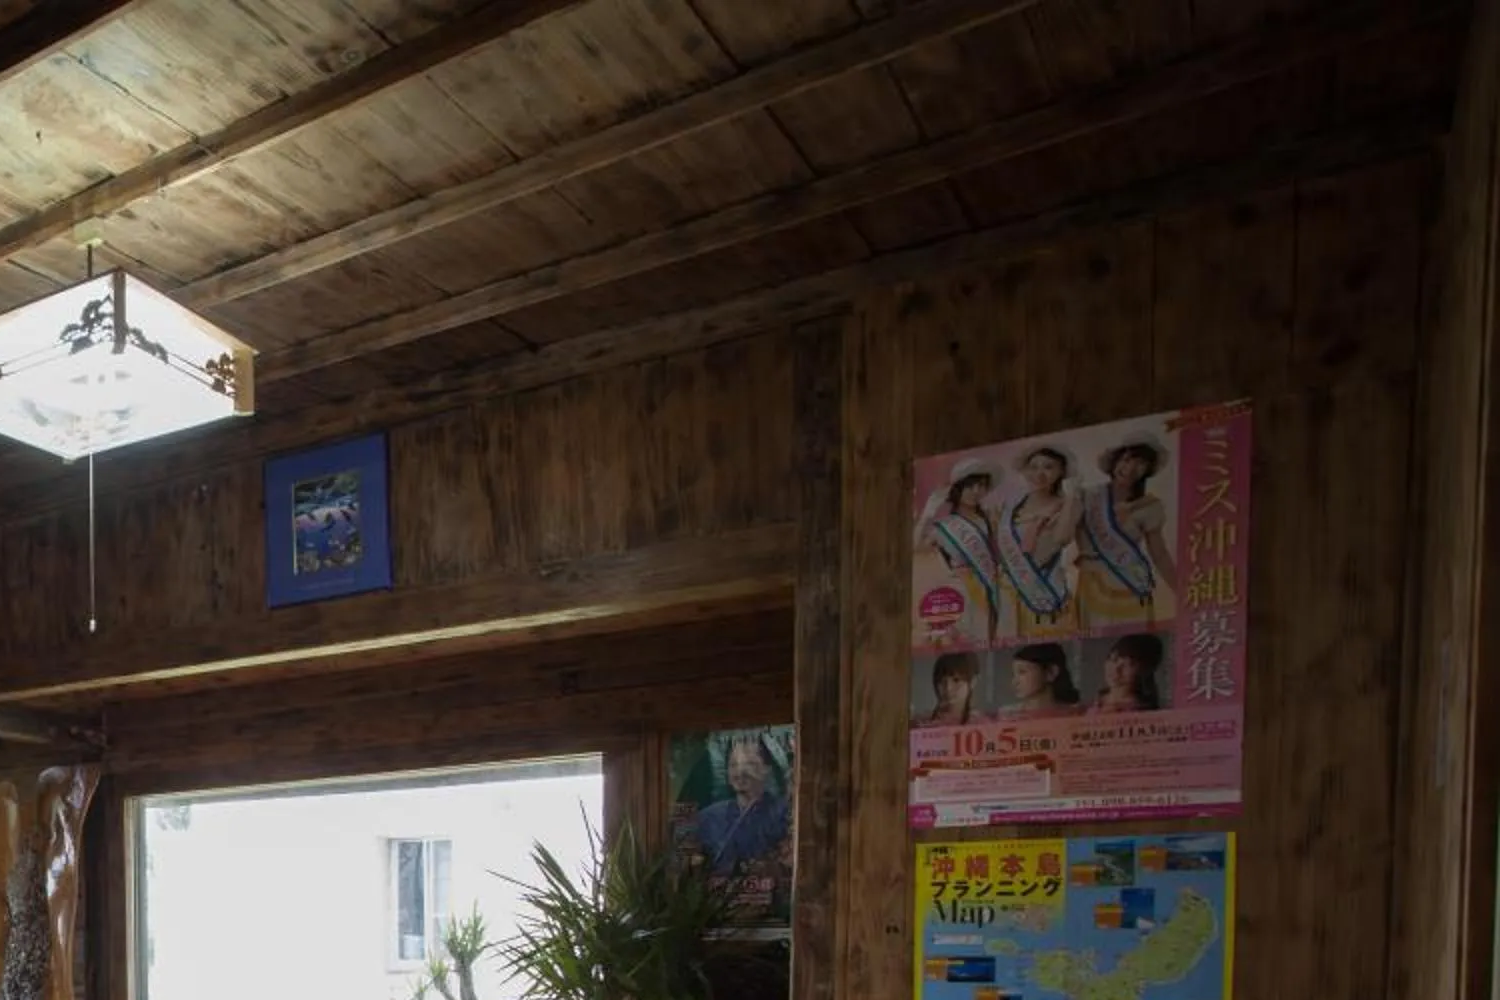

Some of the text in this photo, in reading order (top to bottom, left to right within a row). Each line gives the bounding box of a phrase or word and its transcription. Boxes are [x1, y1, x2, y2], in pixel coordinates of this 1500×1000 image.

[1187, 428, 1239, 701] ミス沖縄募集
[931, 878, 1062, 898] プランニング
[932, 899, 996, 929] Map
